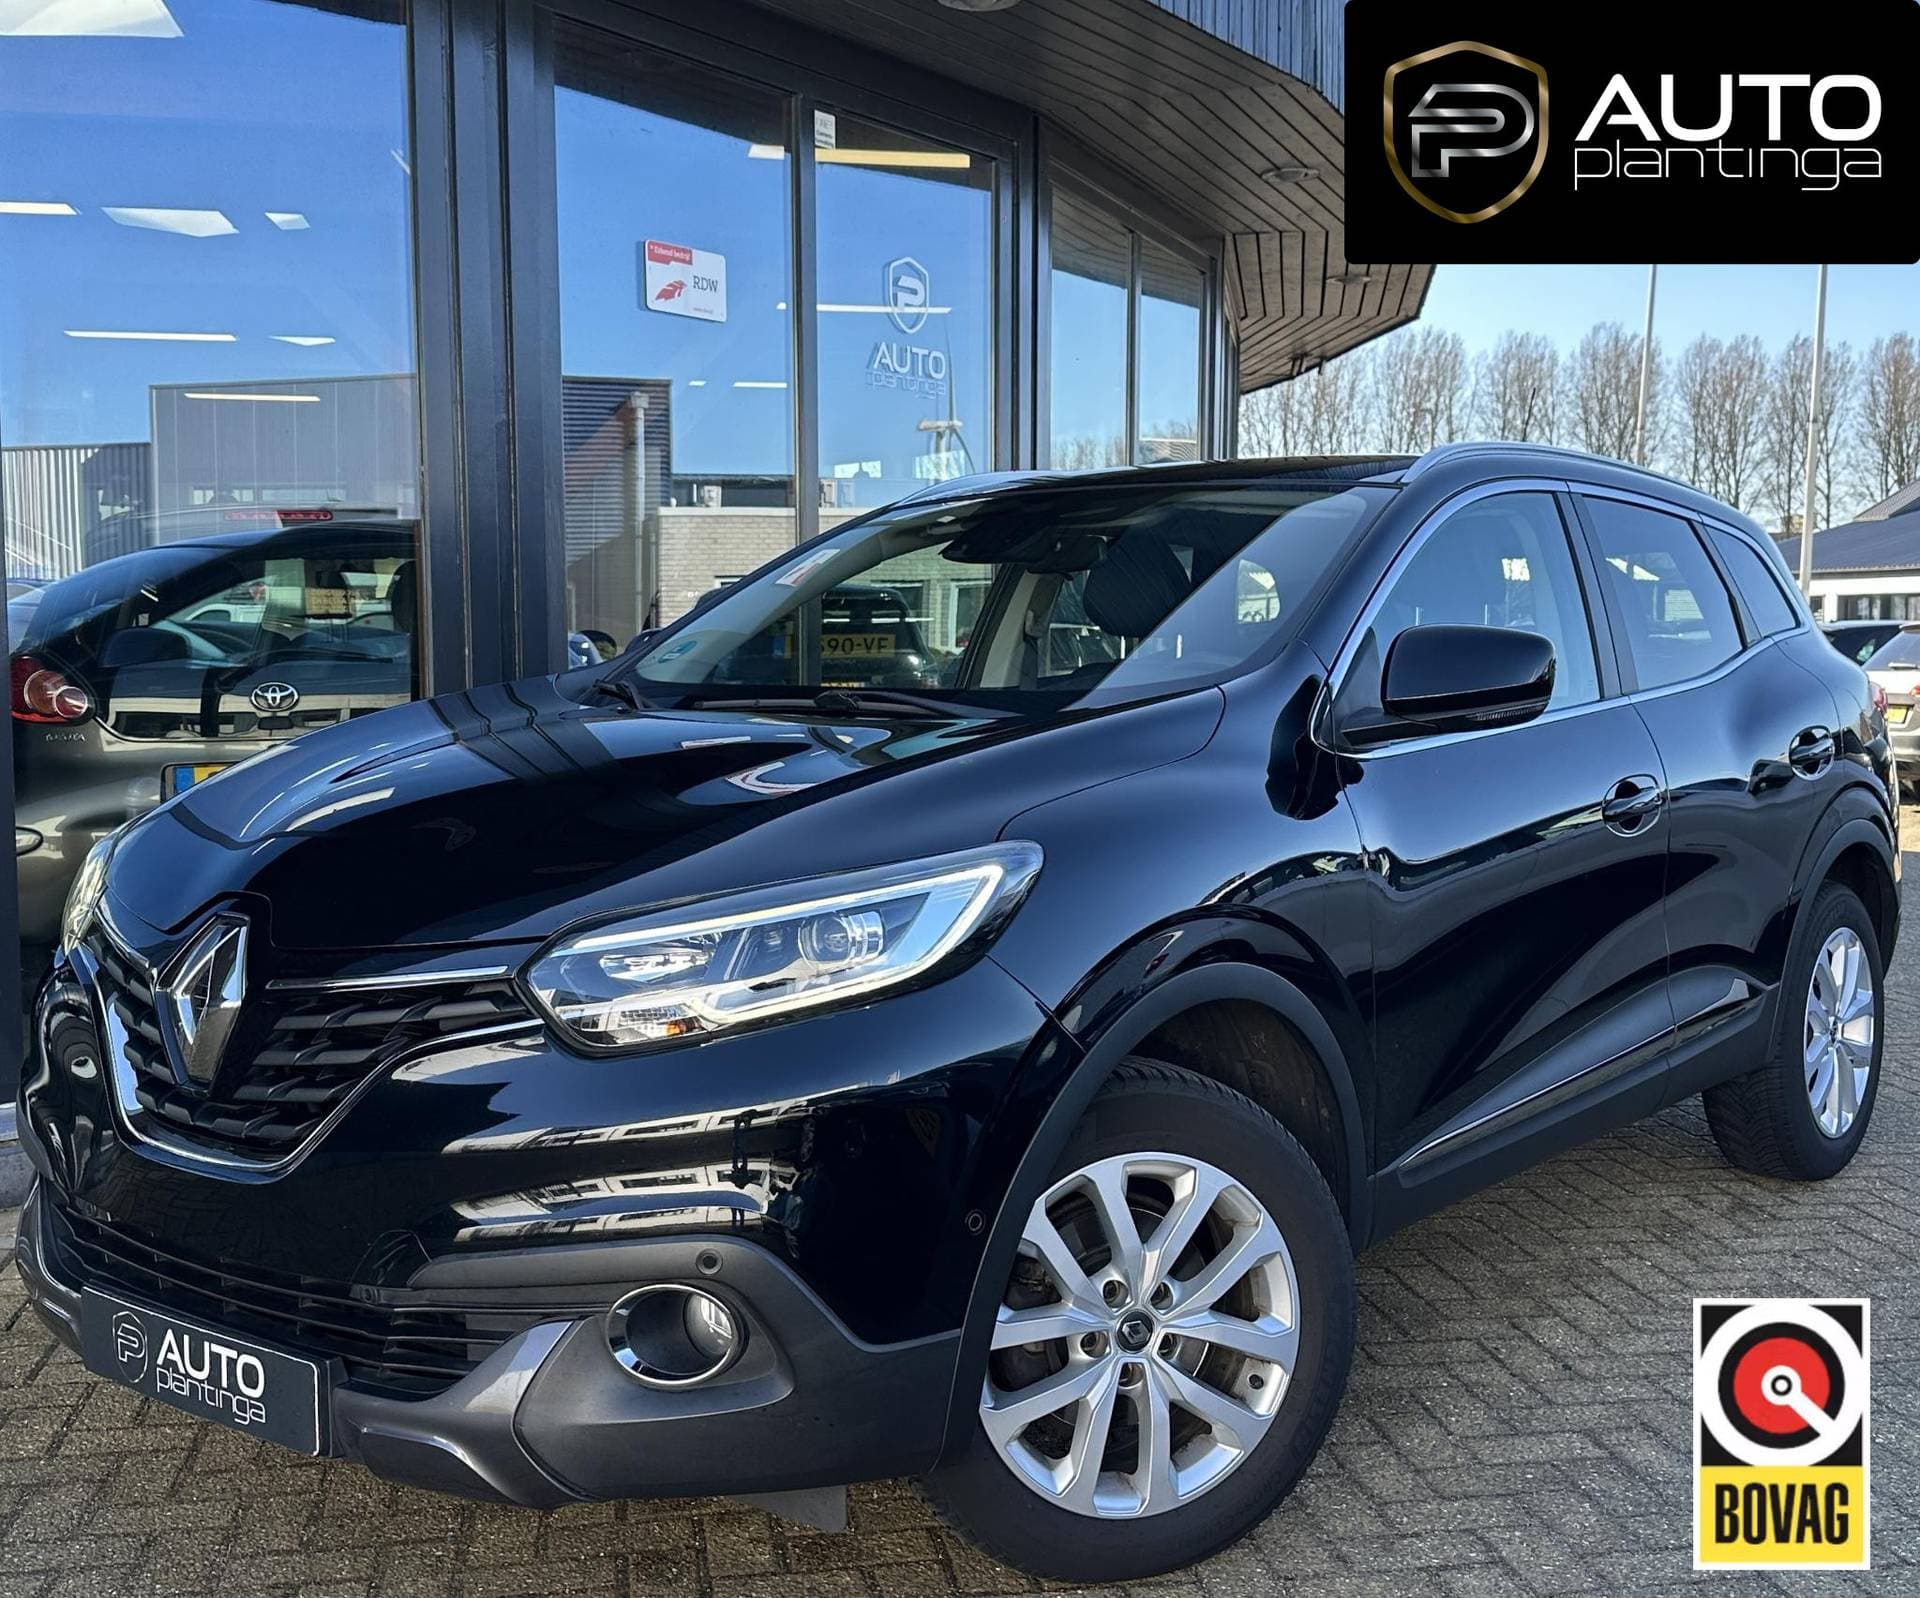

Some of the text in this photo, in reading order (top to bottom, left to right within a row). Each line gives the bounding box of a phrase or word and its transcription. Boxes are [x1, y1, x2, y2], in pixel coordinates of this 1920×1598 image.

[692, 275, 718, 293] RDW
[873, 341, 946, 379] AUTO
[156, 1328, 265, 1399] AUTO
[156, 1367, 266, 1426] plantinga
